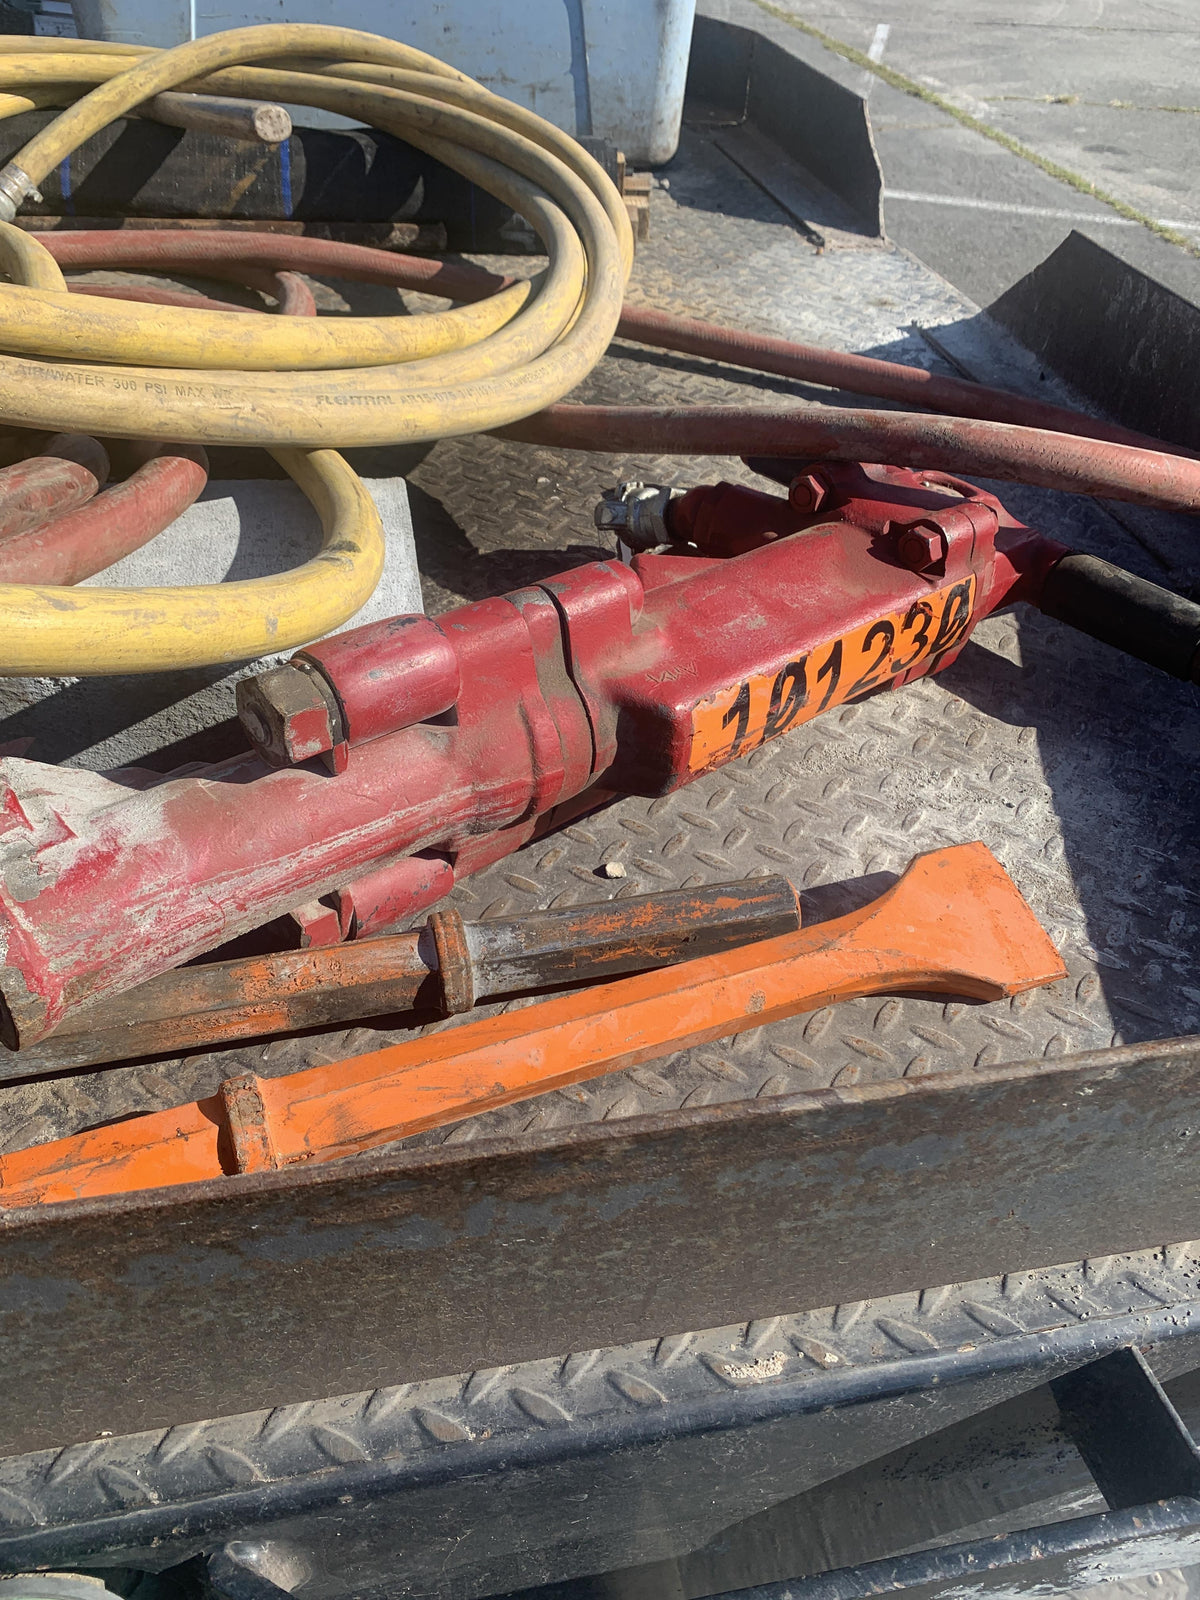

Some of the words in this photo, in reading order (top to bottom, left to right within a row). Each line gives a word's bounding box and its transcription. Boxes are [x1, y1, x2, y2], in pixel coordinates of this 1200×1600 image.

[112, 378, 137, 391] 300
[145, 382, 168, 395] PSI
[175, 385, 206, 398] MAX
